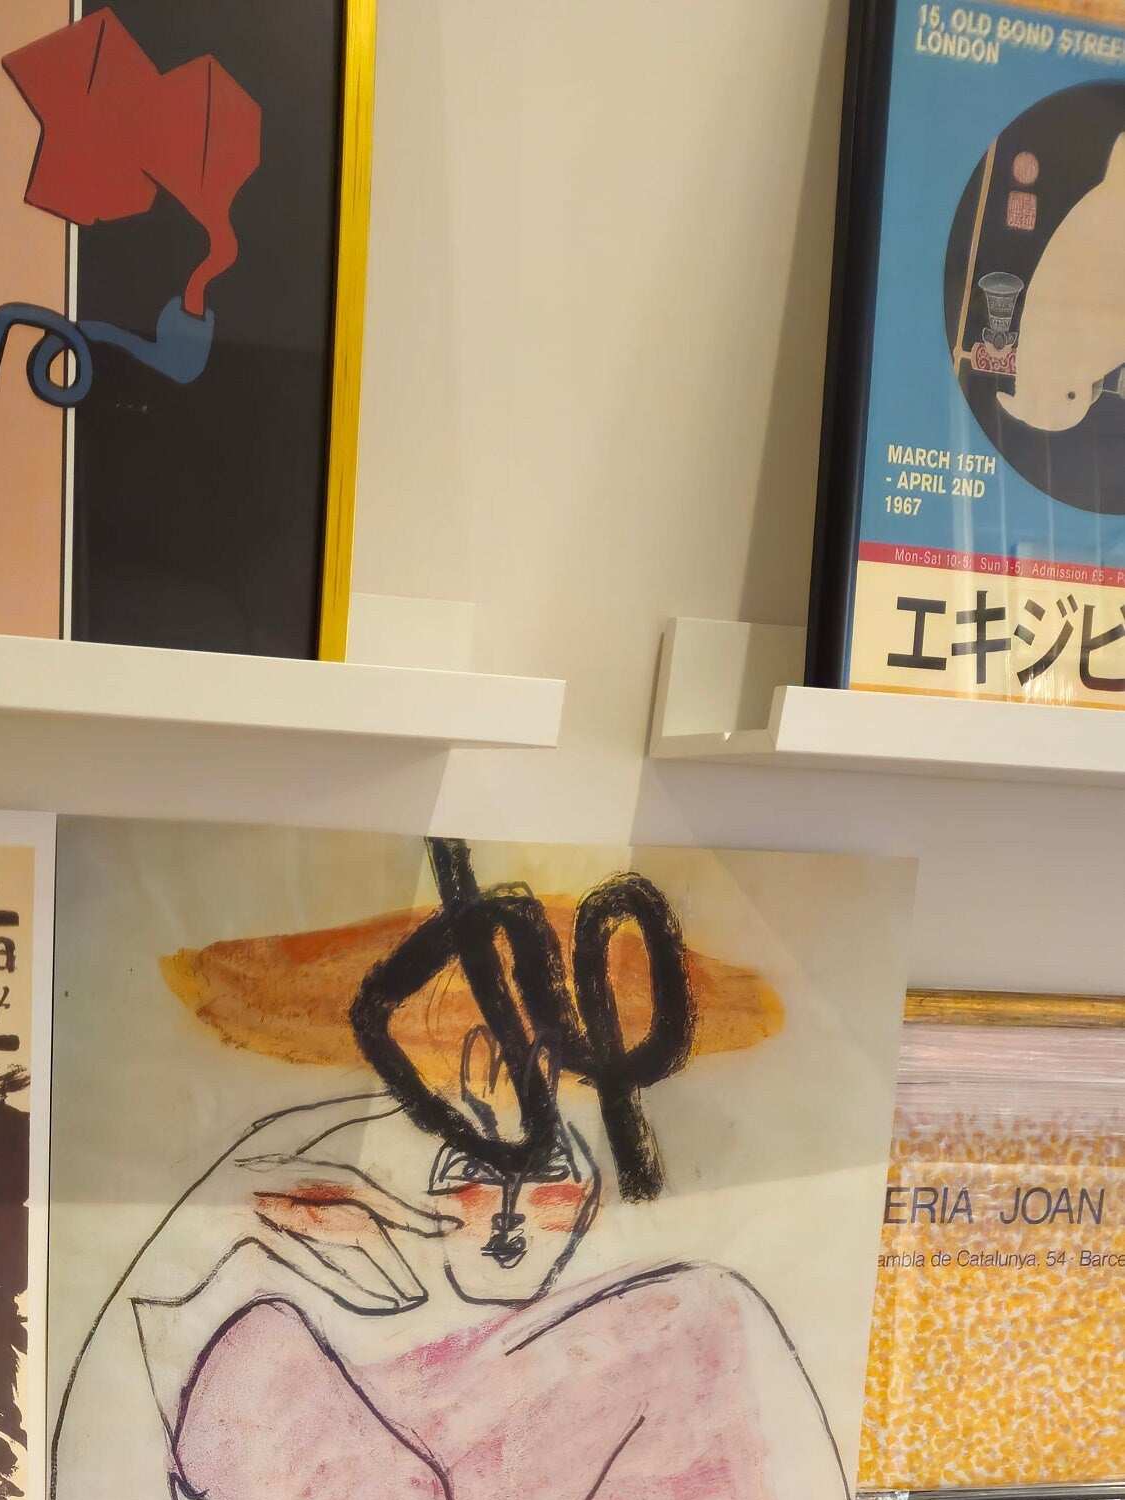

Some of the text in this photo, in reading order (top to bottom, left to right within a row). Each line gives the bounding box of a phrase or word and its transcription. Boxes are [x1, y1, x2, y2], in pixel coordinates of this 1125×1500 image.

[950, 8, 992, 38] OLD
[997, 16, 1055, 49] BOND
[915, 28, 1000, 65] LONDON
[887, 445, 996, 475] MARCH 15TH
[897, 471, 947, 494] APRIL
[952, 477, 985, 499] 2ND
[884, 495, 922, 516] 1967
[979, 557, 1001, 571] Sun
[1032, 562, 1088, 580] Admission
[882, 1186, 1105, 1225] ERIA JOAN
[877, 1250, 926, 1267] ambla
[930, 1250, 952, 1267] de
[1045, 1250, 1067, 1267] 54
